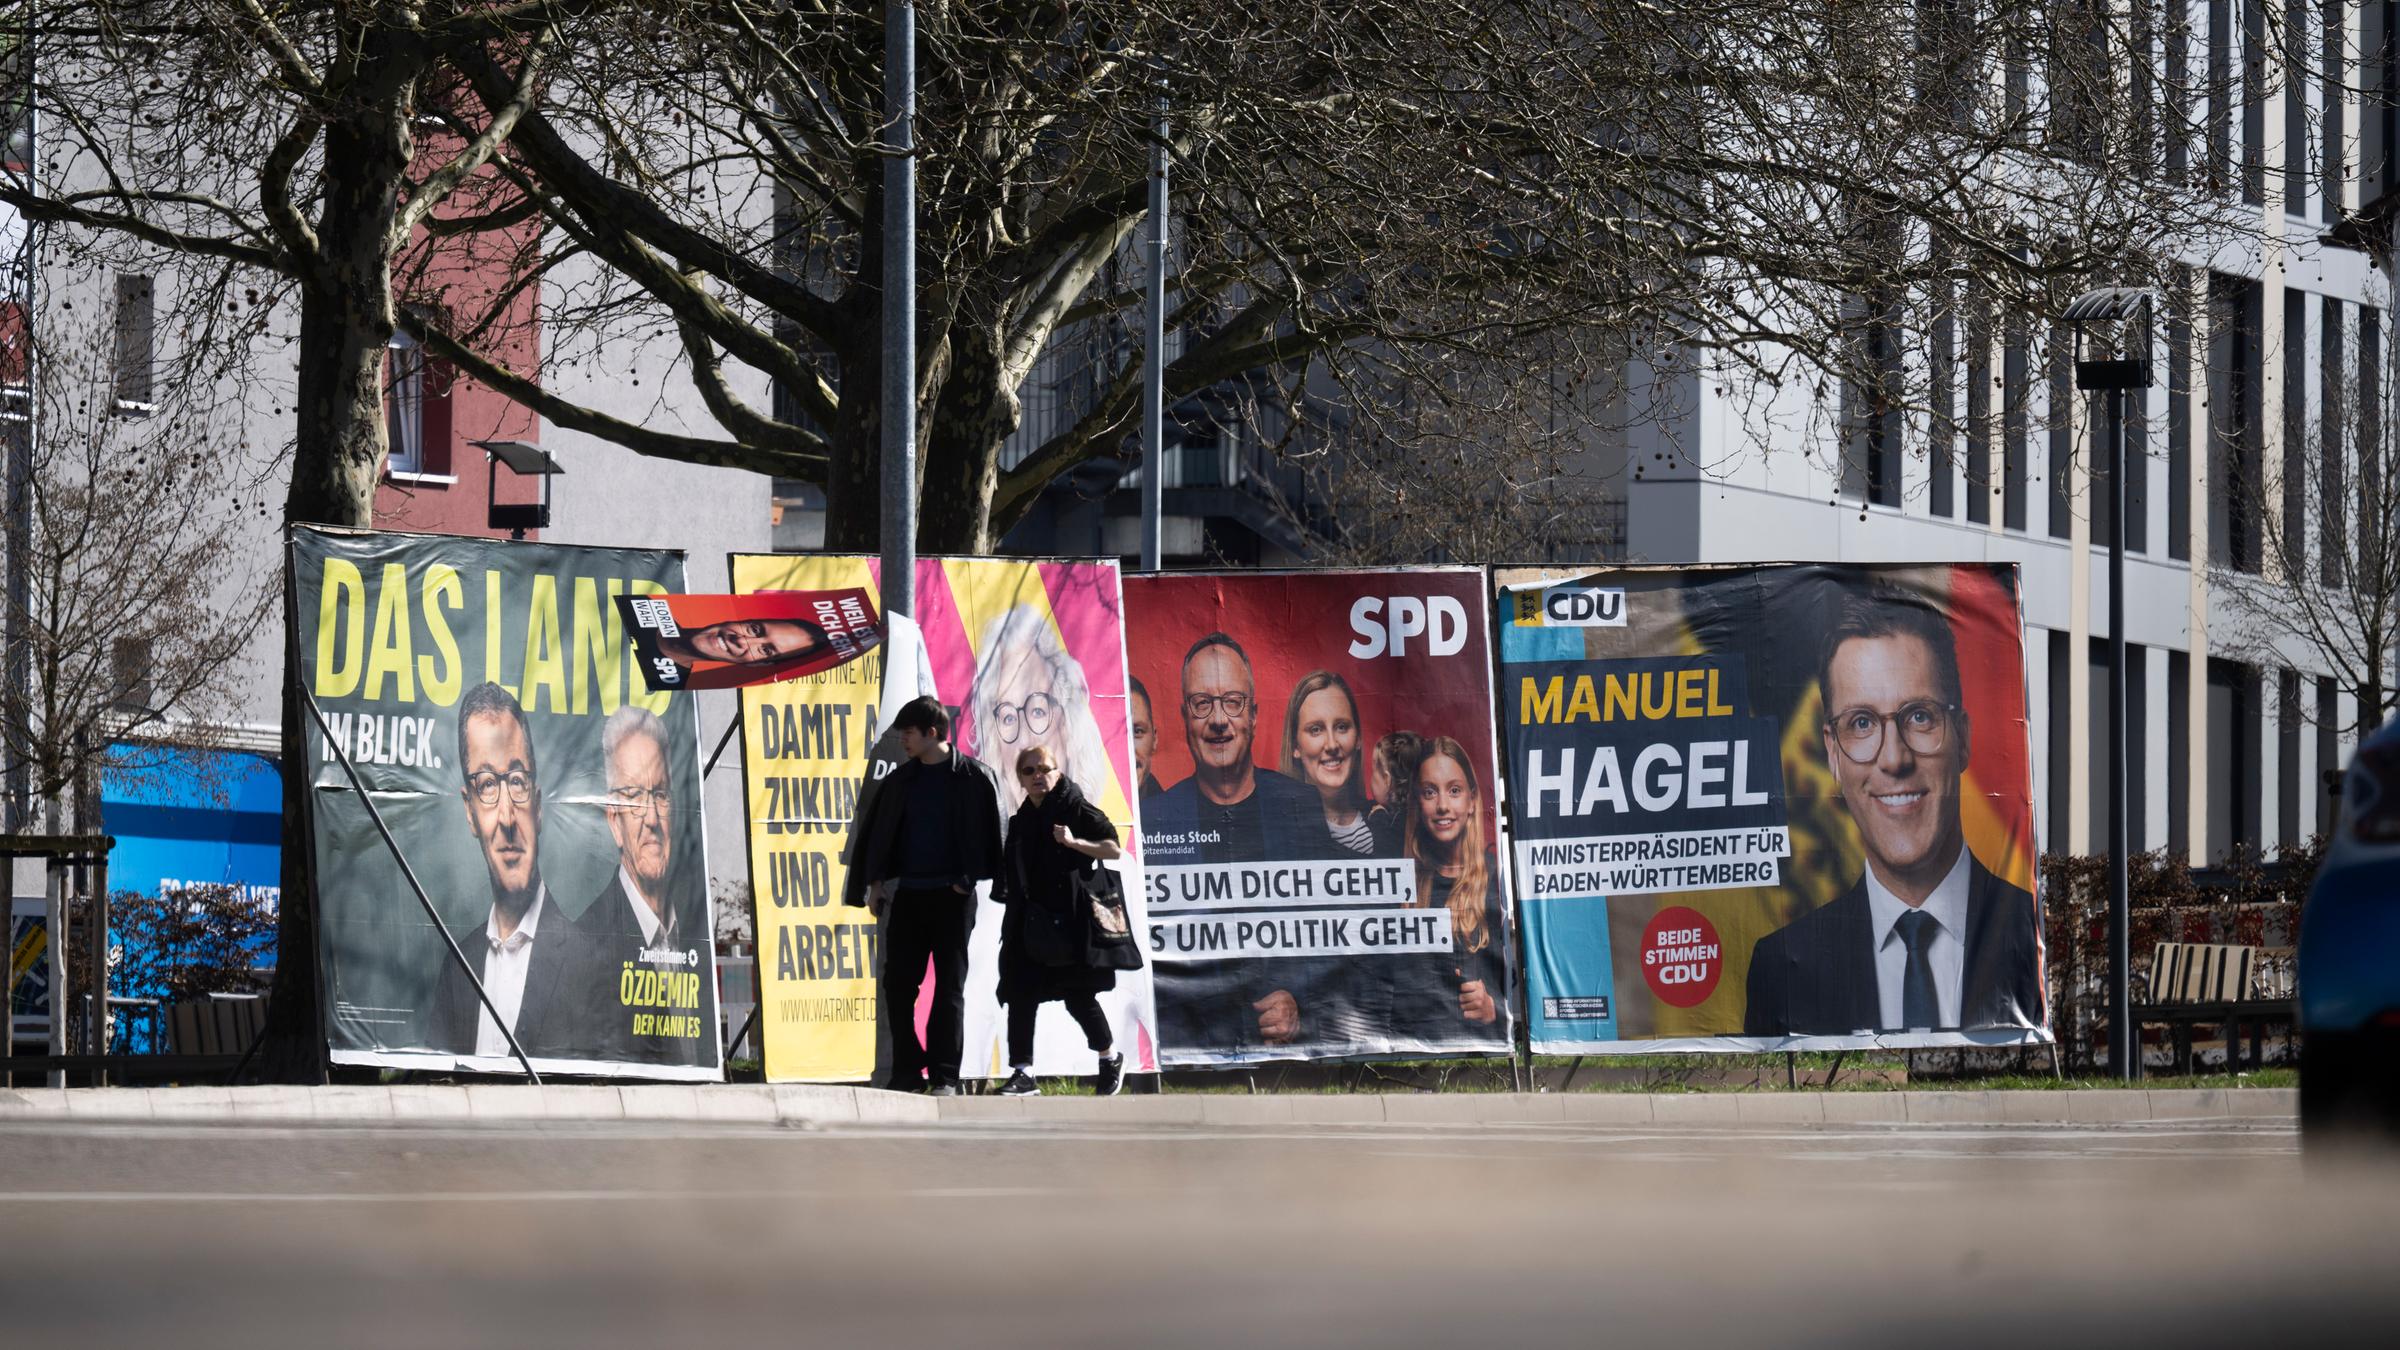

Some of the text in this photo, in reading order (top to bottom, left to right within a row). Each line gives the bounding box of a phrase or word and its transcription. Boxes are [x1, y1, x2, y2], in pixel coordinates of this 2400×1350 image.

[635, 600, 656, 627] WAHL
[653, 600, 677, 637] FLORIAN
[812, 600, 844, 632] DICH
[838, 596, 868, 627] WEIL
[1547, 592, 1620, 621] CDU
[315, 557, 464, 707] DAS
[1348, 596, 1468, 660] SPD
[653, 657, 681, 684] SPD
[1520, 668, 1734, 725] MANUEL
[322, 711, 441, 769] IM BLICK.
[761, 703, 851, 760] DAMIT
[1527, 739, 1769, 818] HAGEL
[1141, 829, 1221, 845] Andreas Stoch
[1531, 828, 1784, 866] MINISTERPRÄSIDENT FÜR
[769, 852, 831, 908] UND
[1145, 867, 1412, 903] ES UM DICH GEHT,
[1534, 861, 1774, 894] BADEN-WÜRTTEMBERG
[777, 923, 877, 981] ARBEIT
[1176, 922, 1228, 952] UM
[1237, 918, 1351, 949] POLITIK
[1360, 916, 1448, 946] GEHT.
[1657, 927, 1702, 947] BEIDE
[1645, 944, 1719, 966] STIMMEN
[620, 961, 701, 1009] ÖZDEMIR
[1658, 962, 1708, 985] CDU
[633, 1013, 701, 1039] DER KANN ES
